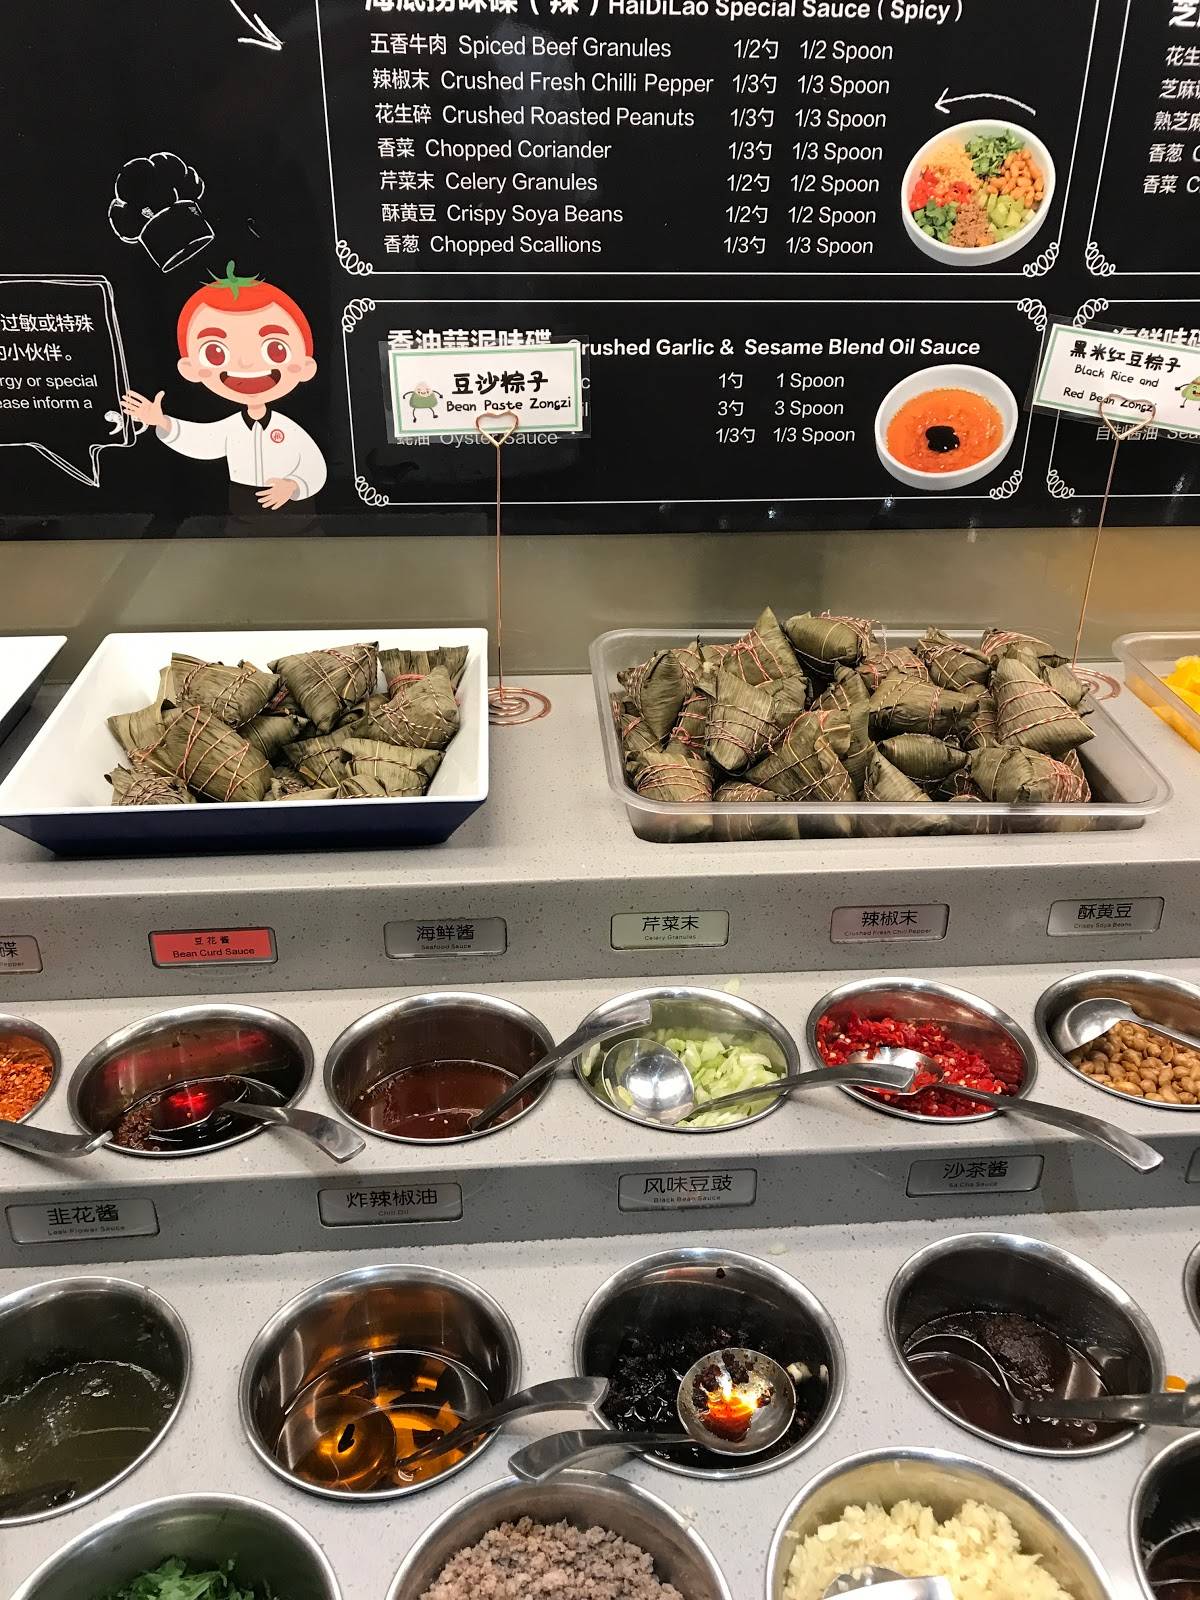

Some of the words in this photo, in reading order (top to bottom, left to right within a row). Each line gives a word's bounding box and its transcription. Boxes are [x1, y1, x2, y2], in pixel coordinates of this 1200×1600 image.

[609, 0, 708, 15] HaiDiLao
[715, 0, 796, 21] Special
[803, 1, 870, 18] Sauce
[891, 1, 950, 24] Spicy
[371, 33, 446, 54] 五香牛肉
[459, 35, 525, 58] Spiced
[533, 36, 578, 55] Beef
[583, 37, 671, 57] Granules
[800, 40, 826, 59] 1/2
[832, 41, 892, 63] Spoon
[373, 68, 430, 90] 辣椒末
[441, 71, 523, 90] Crushed
[531, 72, 585, 91] Fresh
[592, 73, 636, 91] Chilli
[645, 74, 714, 96] Pepper
[798, 75, 823, 93] 1/3
[830, 75, 889, 97] Spoon
[1159, 78, 1200, 99] 芝麻
[375, 103, 431, 124] 花生碎
[443, 105, 524, 124] Crushed
[531, 107, 610, 125] Roasted
[617, 108, 694, 126] Peanuts
[796, 109, 821, 127] 1/3
[827, 109, 886, 131] Spoon
[378, 137, 414, 157] 香菜
[426, 139, 511, 161] Chopped
[518, 140, 612, 158] Coriander
[793, 142, 818, 160] 1/3
[824, 143, 882, 164] Spoon
[1149, 143, 1184, 162] 香葱
[380, 170, 434, 190] 芹菜末
[446, 172, 506, 193] Celery
[513, 173, 597, 190] Granules
[791, 175, 815, 192] 1/2
[821, 175, 879, 195] Spoon
[1143, 175, 1178, 194] 香菜
[382, 203, 436, 222] 酥黄豆
[447, 205, 506, 225] Crispy
[512, 205, 558, 225] Soya
[565, 205, 623, 222] Beans
[789, 206, 813, 223] 1/2
[819, 207, 875, 227] Spoon
[384, 234, 419, 253] 香葱
[431, 236, 513, 256] Chopped
[520, 236, 601, 252] Scallions
[786, 237, 810, 253] 1/3
[817, 237, 873, 257] Spoon
[656, 338, 714, 355] Garlic
[719, 339, 735, 355] &
[744, 339, 823, 355] Sesame
[829, 338, 884, 355] Blend
[889, 338, 916, 355] Oil
[920, 340, 980, 355] Sauce
[1070, 340, 1181, 373] 黑米红豆粽子
[27, 378, 41, 386] or
[46, 375, 97, 389] special
[452, 370, 548, 394] 豆沙粽子
[777, 373, 783, 387] 1
[790, 373, 844, 391] Spoon
[1075, 364, 1105, 378] Black
[1110, 371, 1134, 383] Rice
[1139, 377, 1160, 388] and
[33, 396, 79, 408] inform
[84, 400, 92, 408] a
[446, 400, 477, 412] Bean
[484, 399, 523, 411] Paste
[529, 397, 571, 410] Zongzi
[1063, 387, 1085, 399] Red
[1089, 392, 1115, 405] Bean
[775, 401, 784, 415] 3
[790, 401, 843, 418] Spoon
[773, 428, 797, 443] 1/3
[801, 428, 855, 447] Spoon
[862, 910, 918, 927] 辣椒末
[1077, 903, 1133, 919] 酥黄豆
[416, 924, 475, 941] 海鲜酱
[642, 915, 699, 931] 芹菜末
[173, 949, 197, 958] Bean
[200, 948, 222, 957] Curd
[225, 947, 255, 955] Sauce
[943, 1161, 1009, 1179] 沙茶酱
[643, 1174, 733, 1194] 风味豆豉
[346, 1188, 438, 1209] 炸辣椒油
[47, 1204, 119, 1226] 韭花酱
